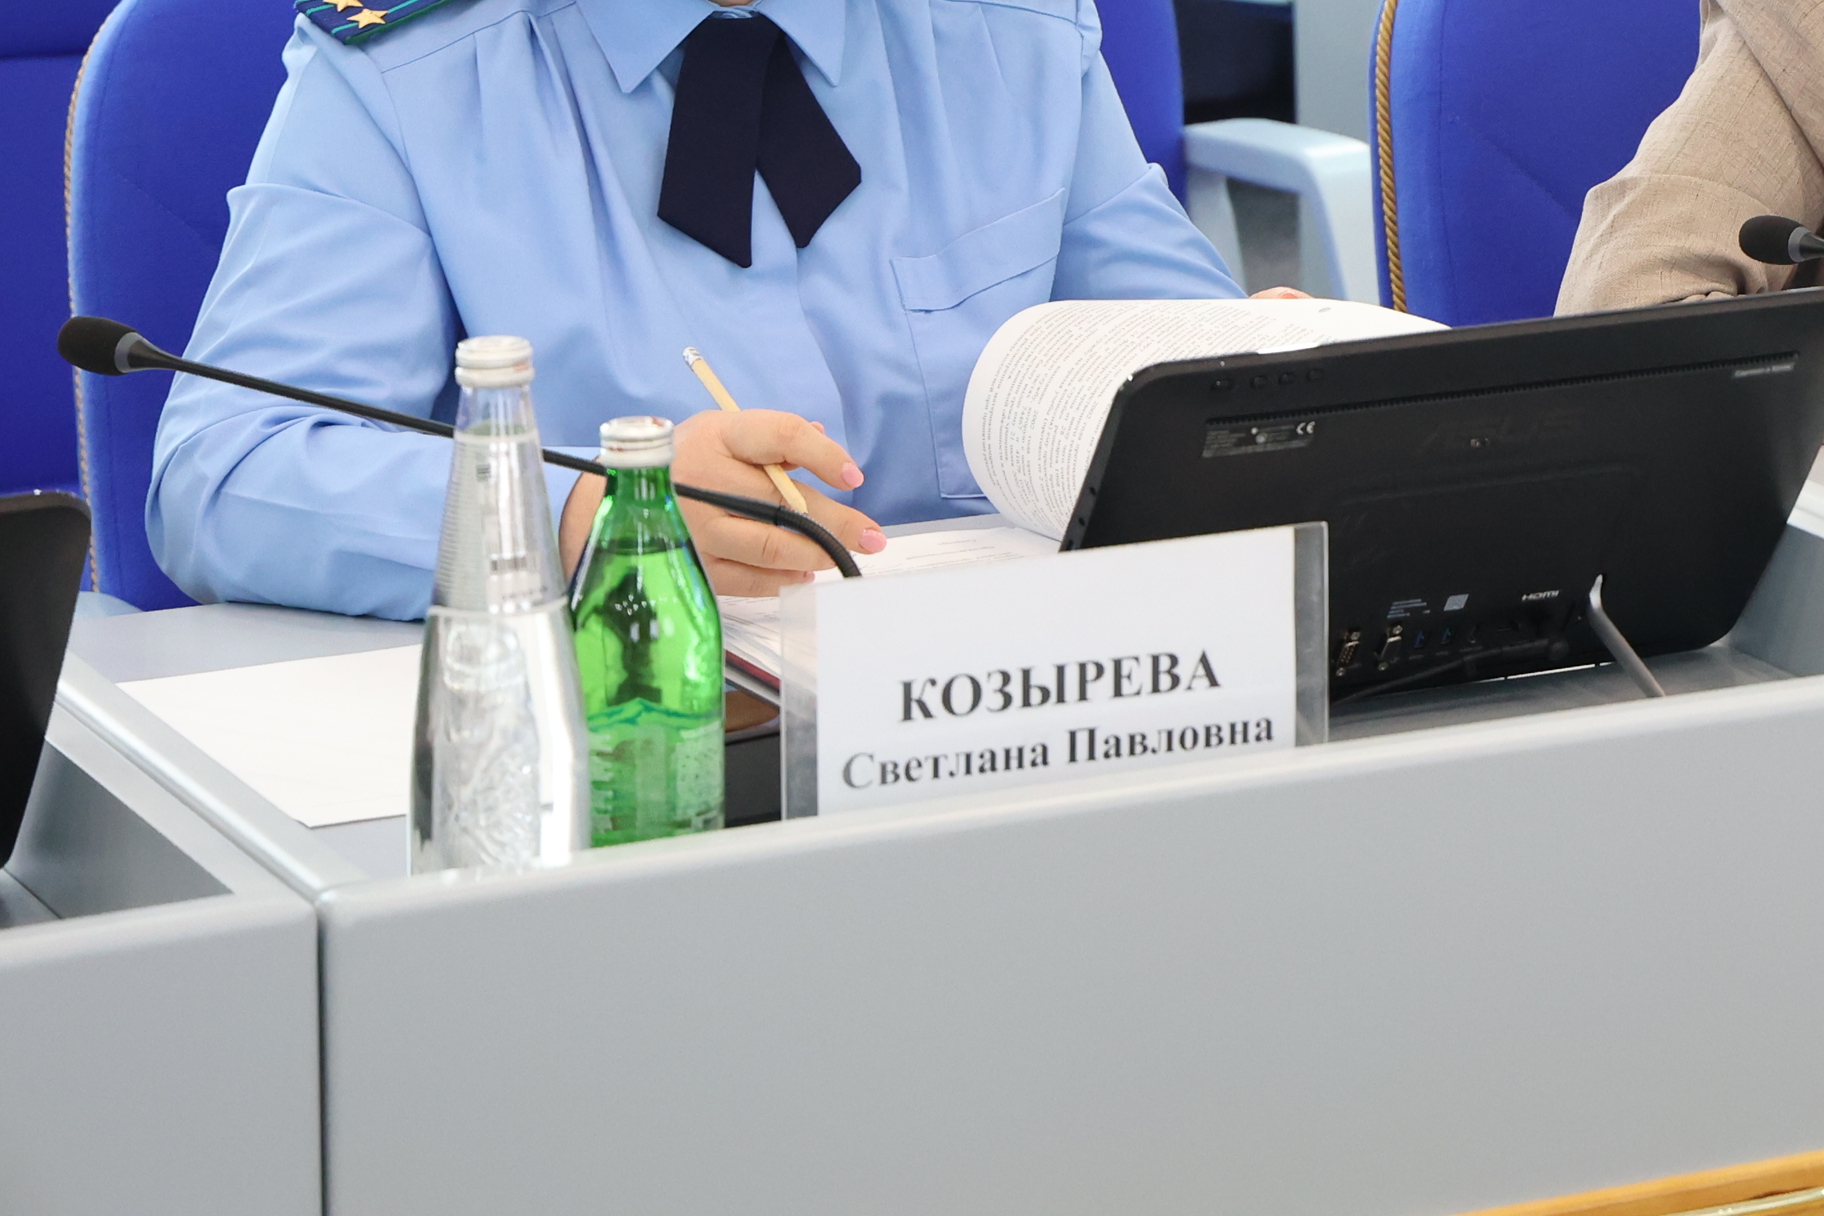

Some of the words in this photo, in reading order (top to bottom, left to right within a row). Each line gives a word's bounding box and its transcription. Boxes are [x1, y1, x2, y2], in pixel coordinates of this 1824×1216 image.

[1036, 365, 1061, 405] кампанию
[1068, 384, 1085, 409] закона
[983, 393, 992, 410] при
[1044, 390, 1061, 416] учебы
[1072, 369, 1113, 439] государственного
[1084, 400, 1100, 420] 2002
[986, 391, 999, 441] материалов
[1010, 411, 1019, 426] ему
[1063, 415, 1076, 440] ввиду
[1043, 431, 1051, 449] ему
[1076, 421, 1087, 441] года
[1053, 438, 1062, 464] марта
[1071, 443, 1080, 491] претендент
[898, 648, 1222, 724] КОЗЫРЕВА
[841, 742, 1051, 790] Светлана
[1065, 715, 1275, 765] Павловна
